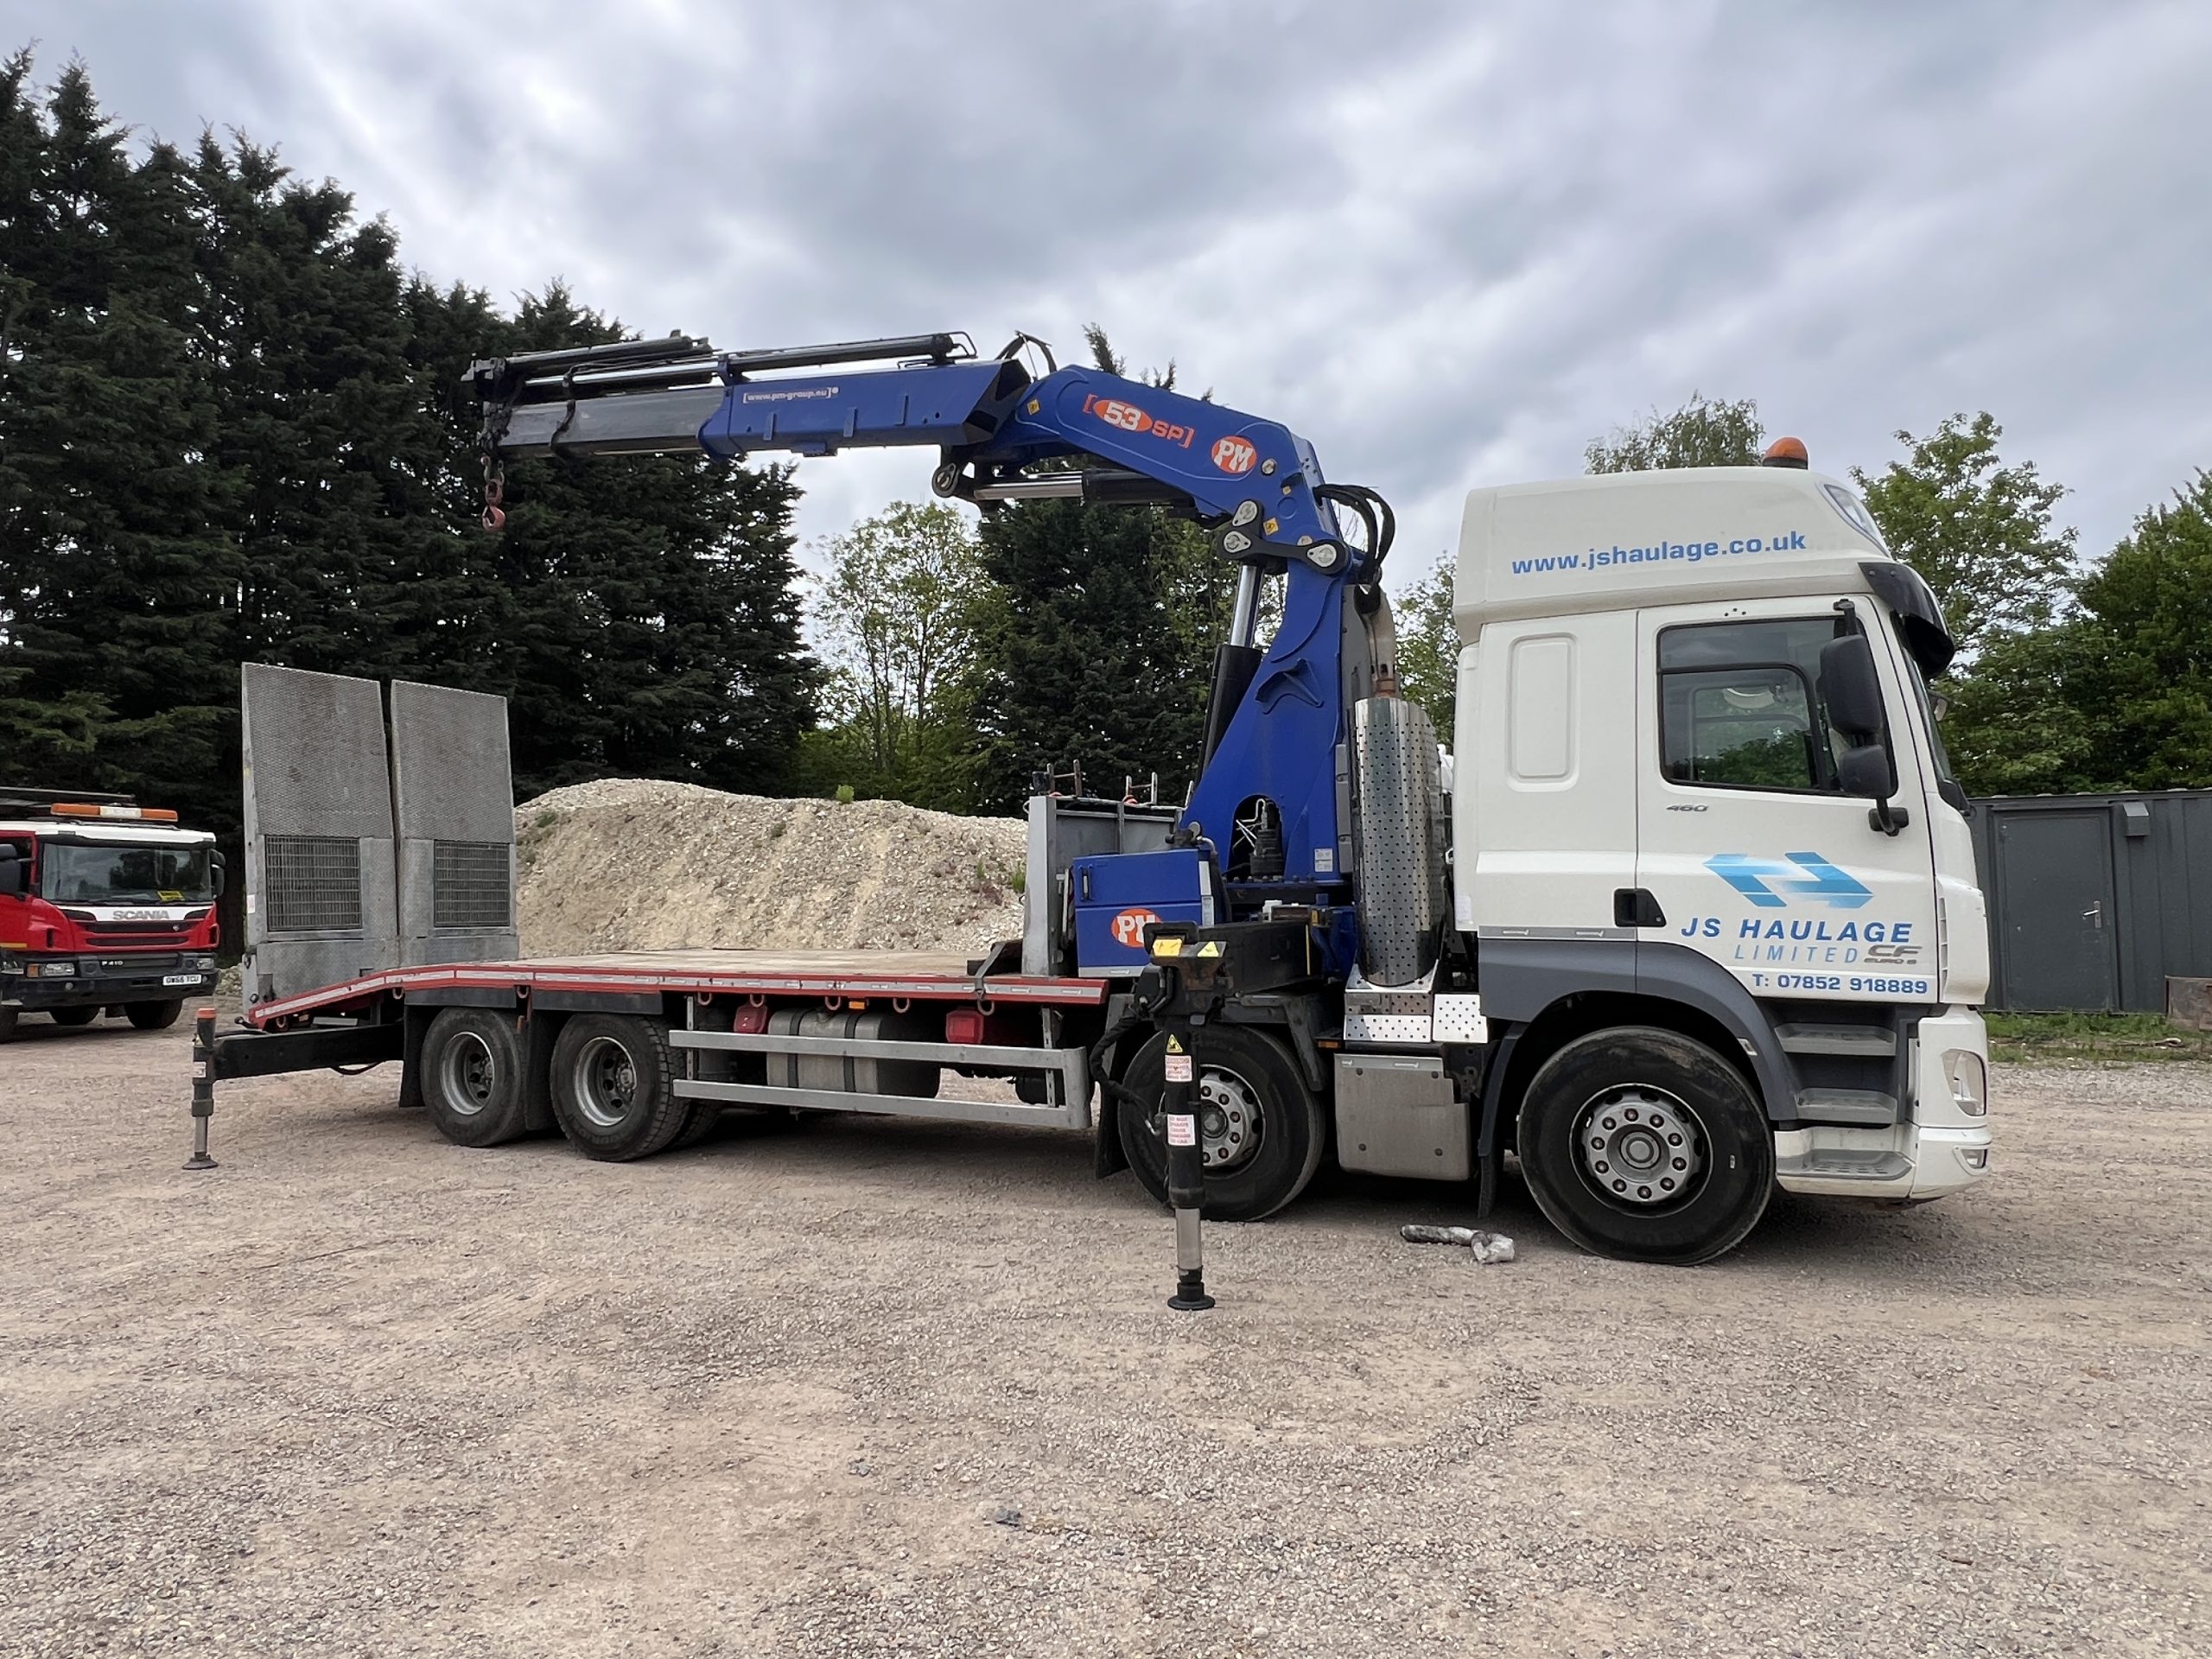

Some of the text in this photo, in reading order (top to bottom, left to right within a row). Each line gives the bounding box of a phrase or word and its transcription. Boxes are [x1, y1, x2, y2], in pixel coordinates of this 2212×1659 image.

[1213, 440, 1254, 472] PM
[1511, 530, 1807, 574] www.jshaulage.co.uk
[112, 910, 170, 920] SCANIA
[1681, 918, 1913, 943] JS HAULAGE
[1734, 944, 1859, 963] LIMITED
[1868, 944, 1923, 957] CF
[1751, 973, 1928, 995] T: 07852 918889
